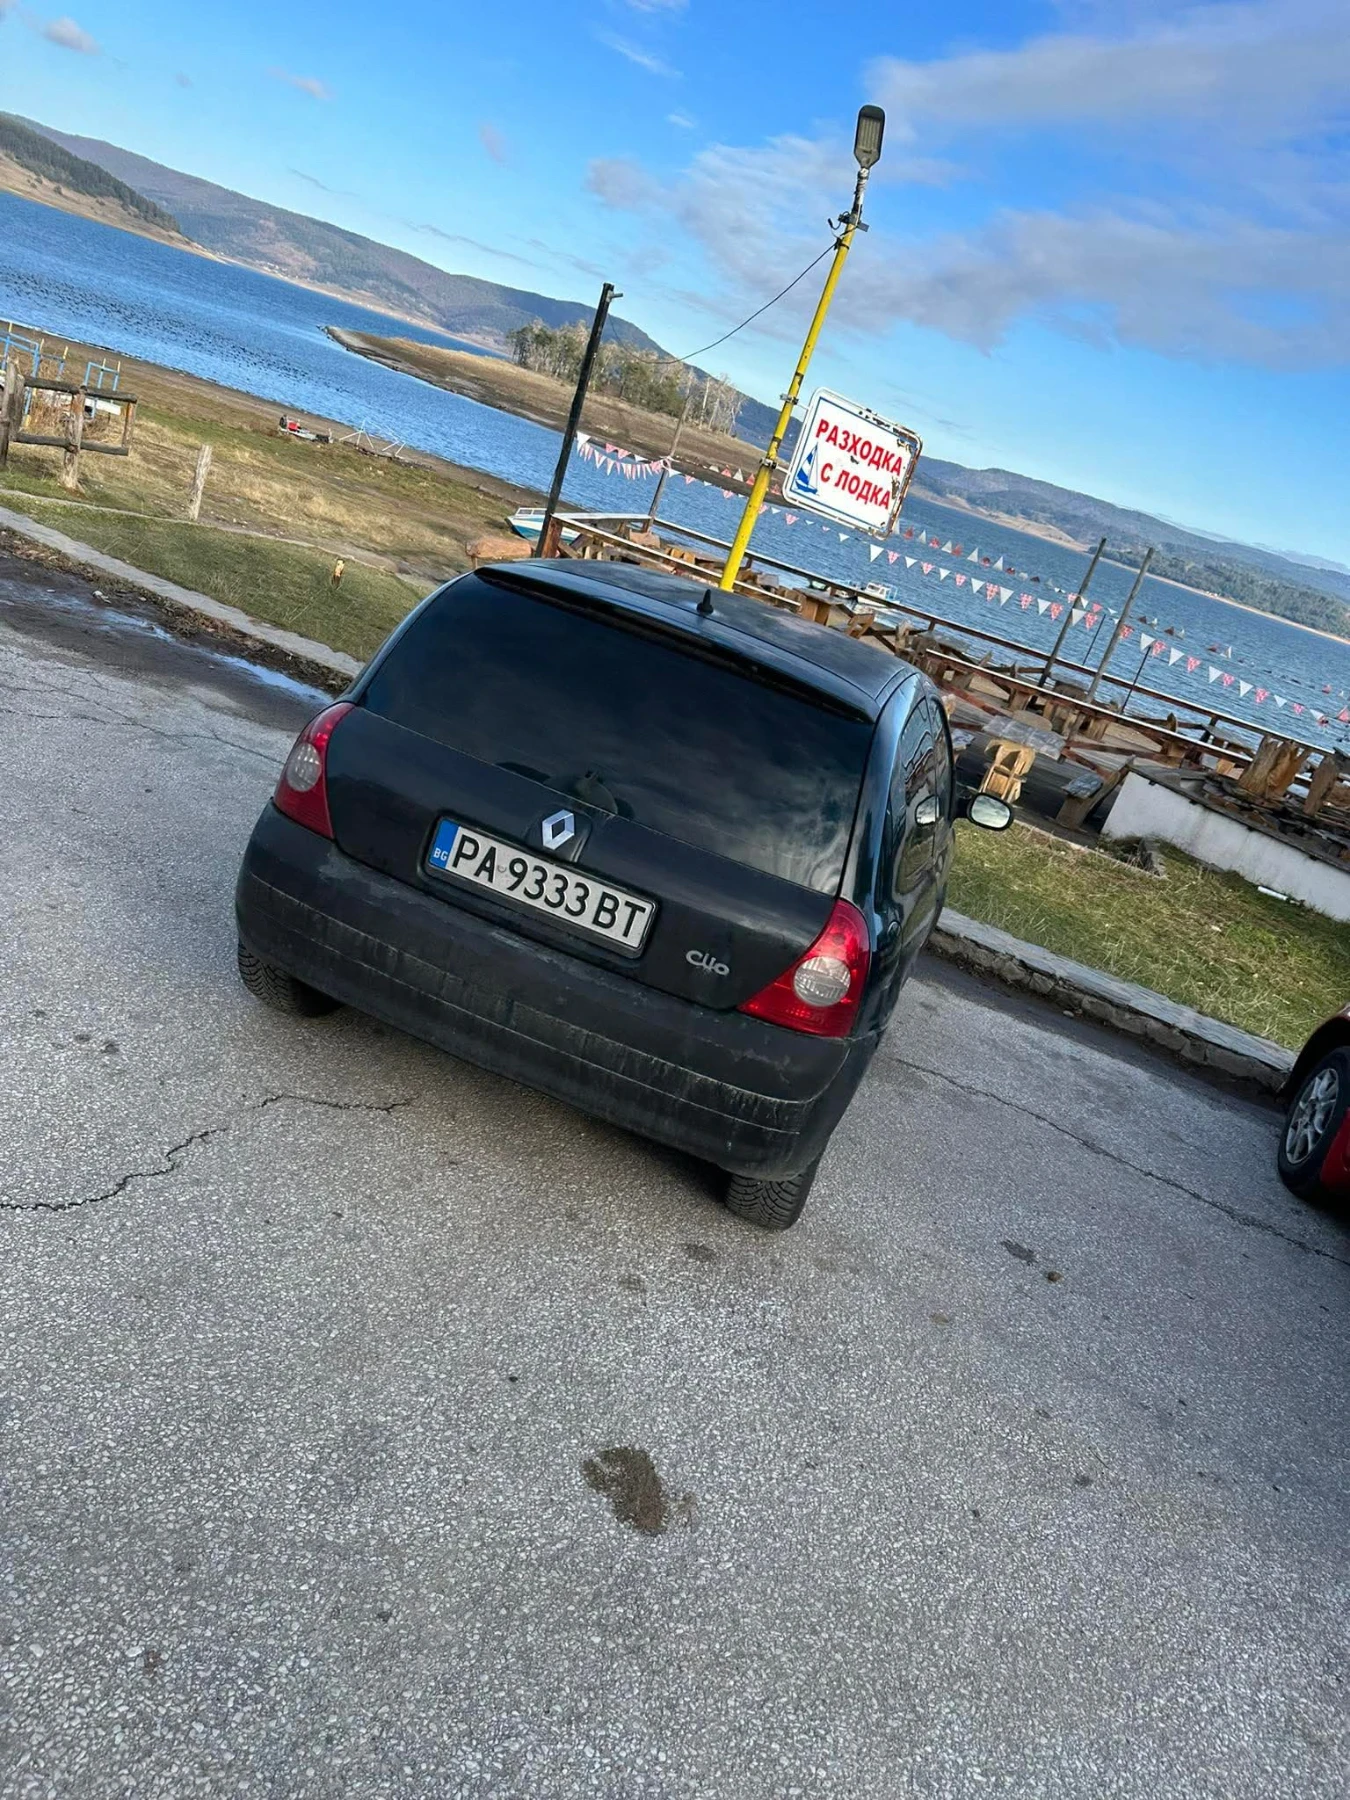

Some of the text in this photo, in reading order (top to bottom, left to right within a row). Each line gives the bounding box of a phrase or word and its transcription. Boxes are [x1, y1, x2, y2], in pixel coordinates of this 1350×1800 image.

[816, 419, 903, 476] РАЗХОДКА
[821, 463, 890, 509] С ЛОДКА
[433, 847, 448, 861] BG
[451, 834, 646, 937] PA 9333 BT
[685, 949, 730, 977] Clio
